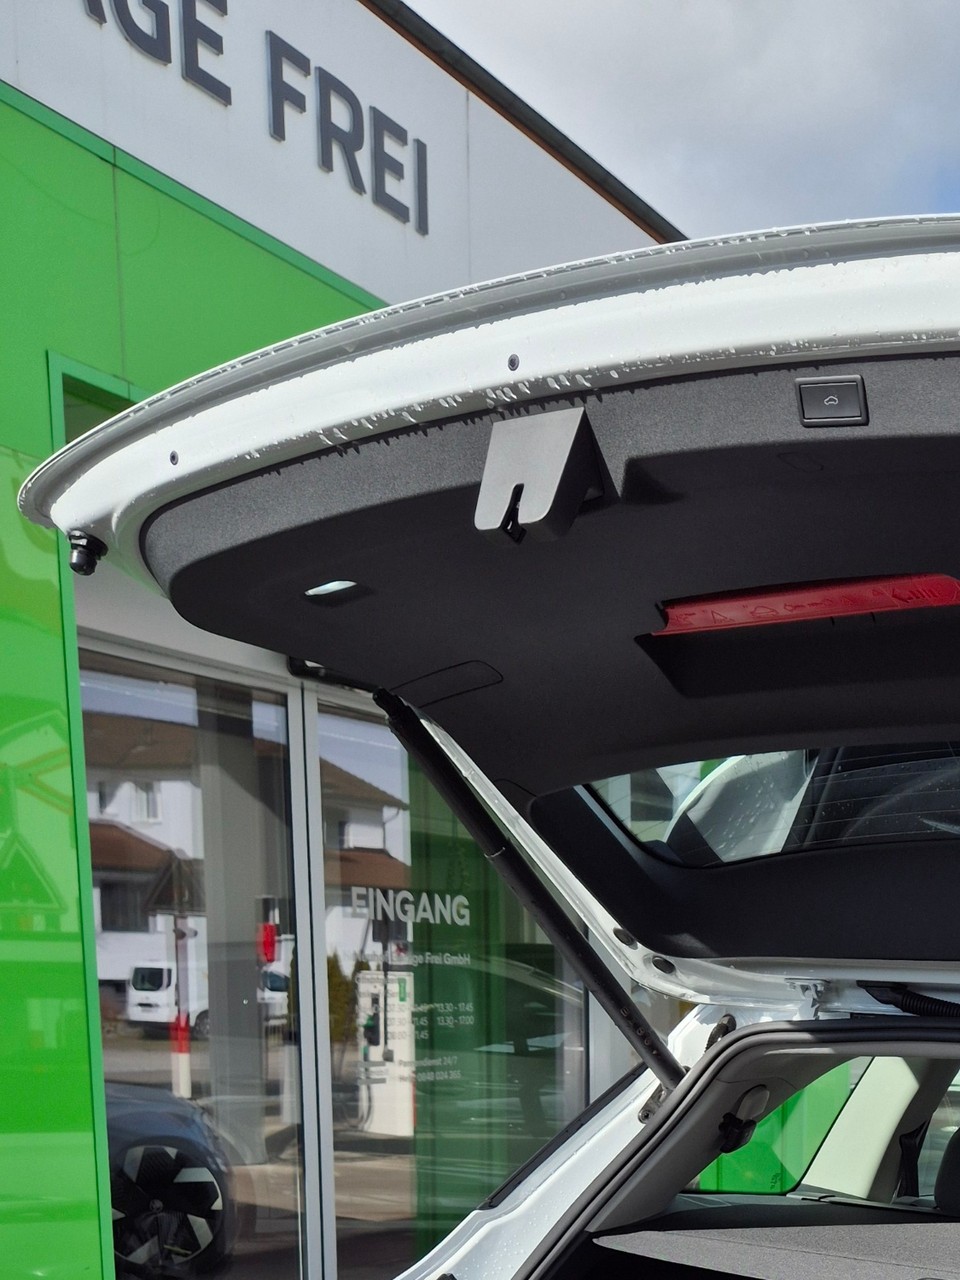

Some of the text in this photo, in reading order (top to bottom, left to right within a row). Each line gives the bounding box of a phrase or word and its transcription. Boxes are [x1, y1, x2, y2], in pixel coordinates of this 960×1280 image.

[84, 0, 429, 236] GE FREI
[351, 886, 470, 926] EINGANG
[425, 952, 443, 965] Frei
[444, 953, 471, 965] GmbH
